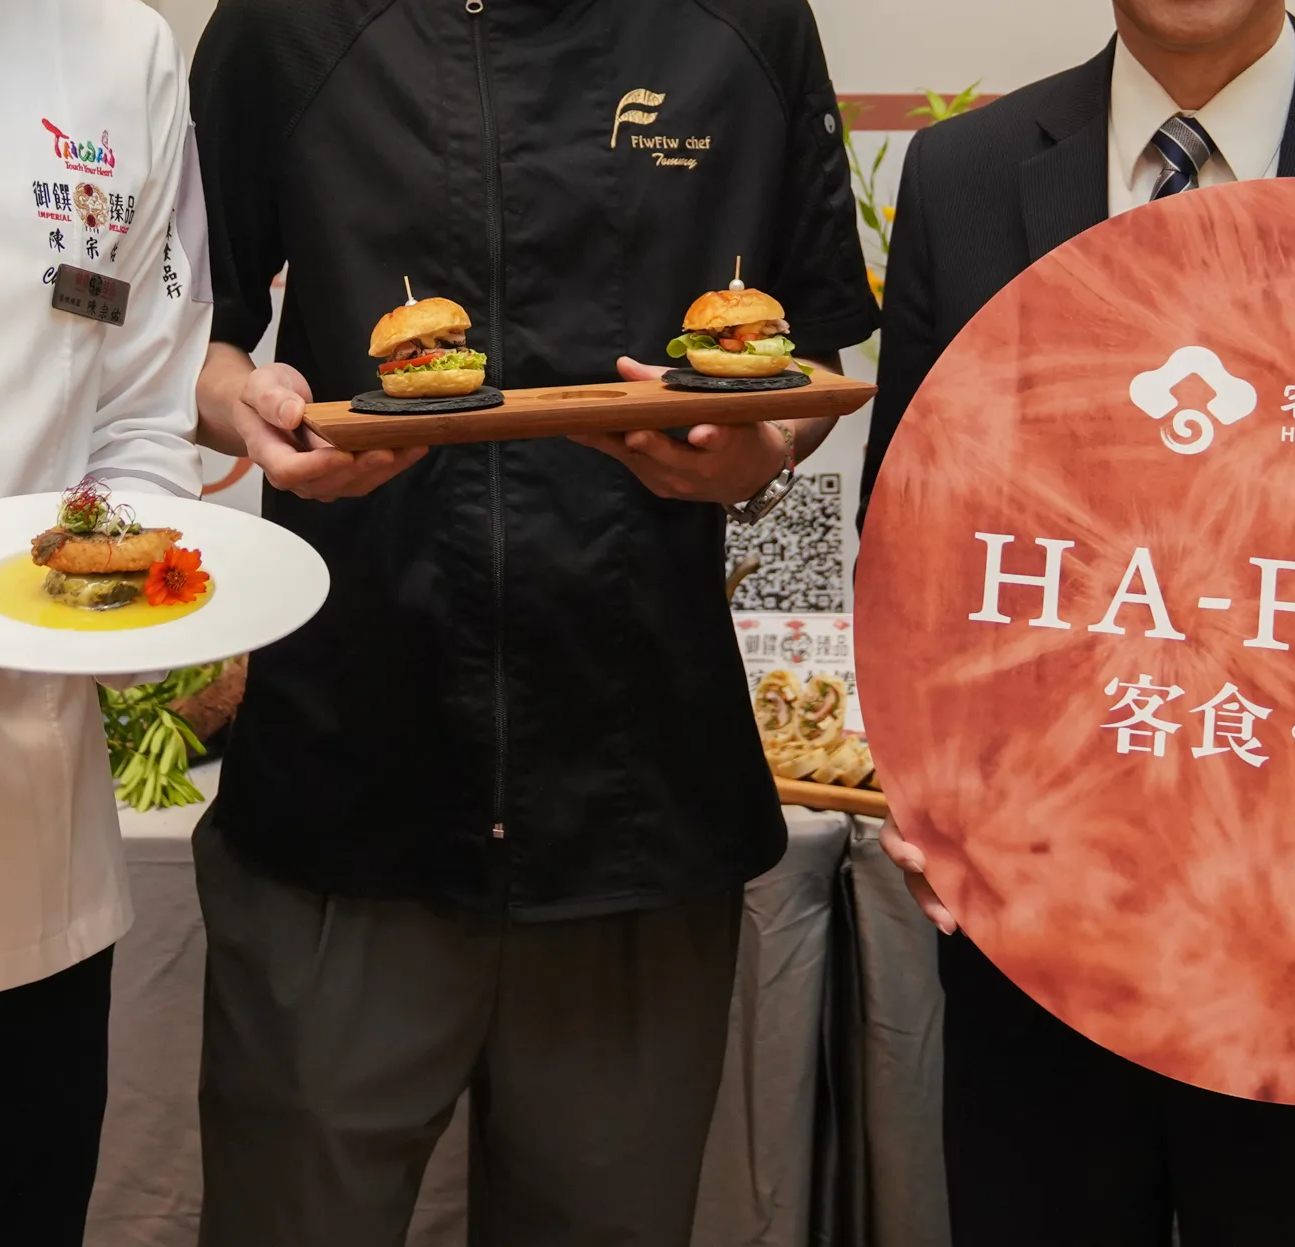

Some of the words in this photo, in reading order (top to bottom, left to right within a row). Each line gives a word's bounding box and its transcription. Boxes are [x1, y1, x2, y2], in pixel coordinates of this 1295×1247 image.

[685, 135, 712, 149] chef
[651, 152, 698, 170] Tommy
[65, 161, 84, 172] Touch
[83, 164, 96, 175] Your
[96, 167, 113, 177] Heart
[38, 210, 72, 222] IMPERIAL
